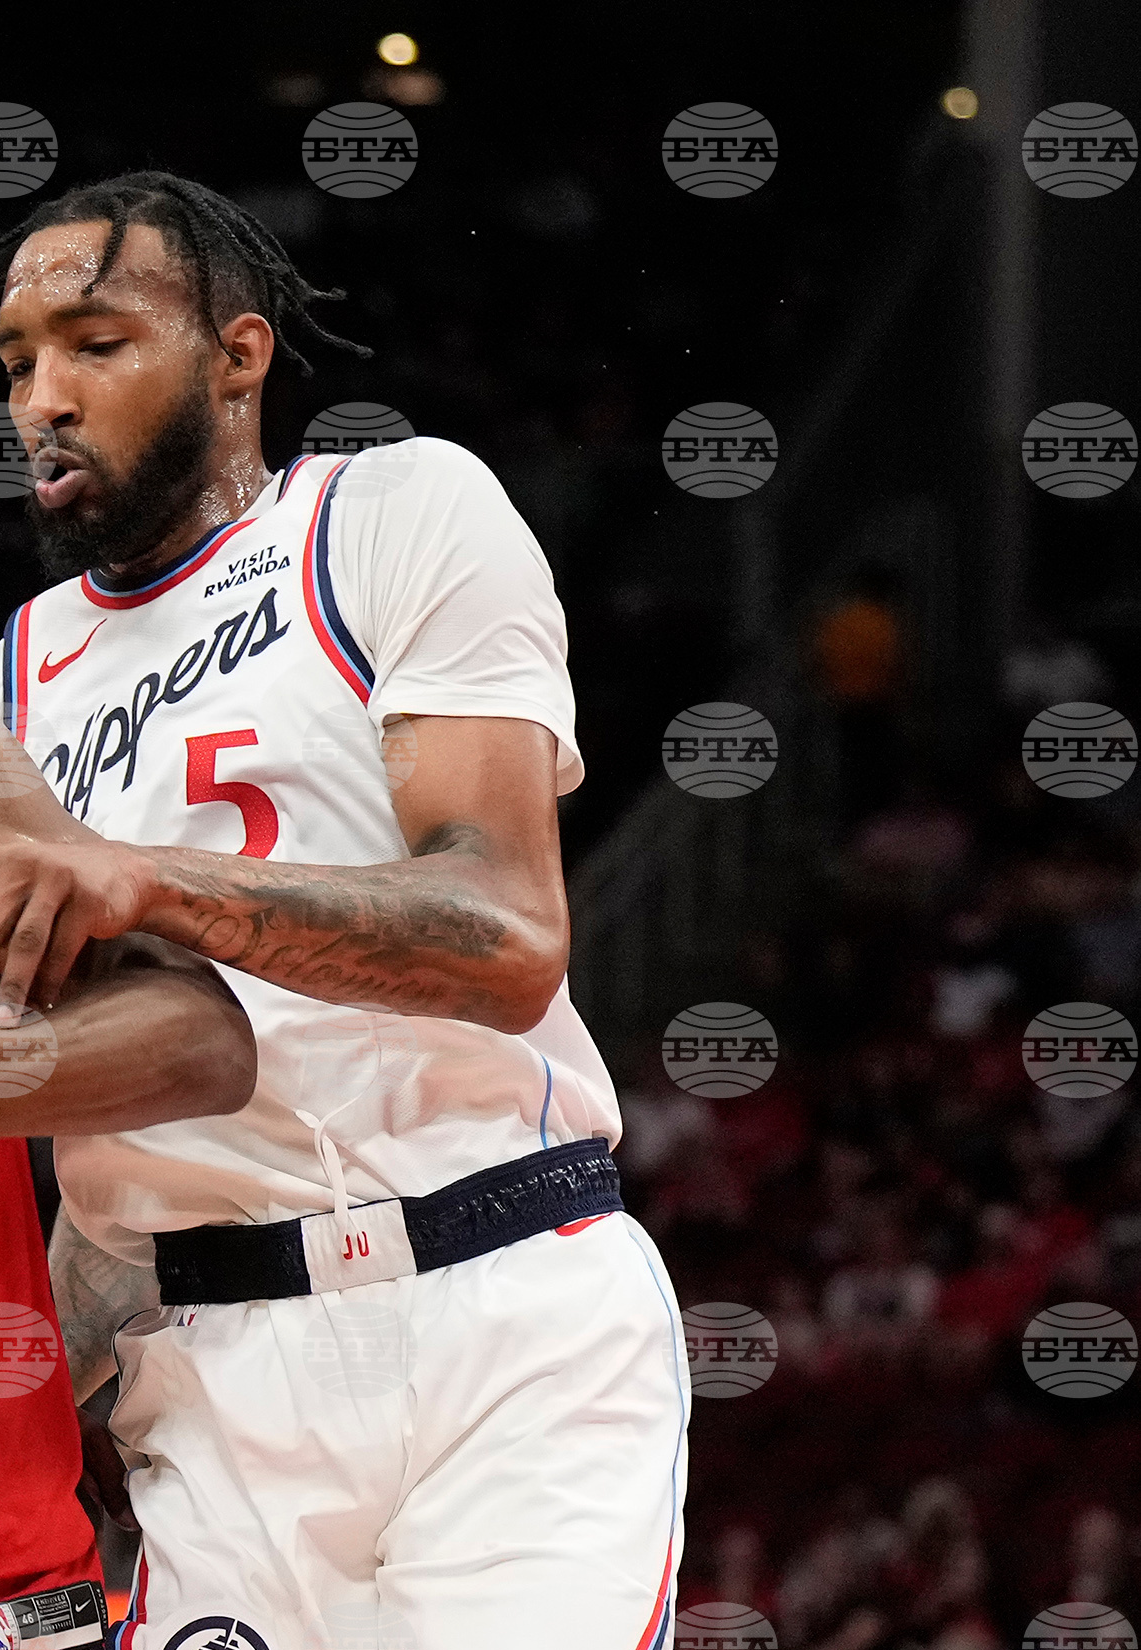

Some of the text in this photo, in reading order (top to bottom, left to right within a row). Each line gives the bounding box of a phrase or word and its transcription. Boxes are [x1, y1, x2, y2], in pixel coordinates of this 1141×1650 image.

[204, 555, 291, 598] RWANDA
[228, 545, 276, 575] VISIT
[185, 729, 279, 859] 5
[22, 1613, 34, 1624] 46
